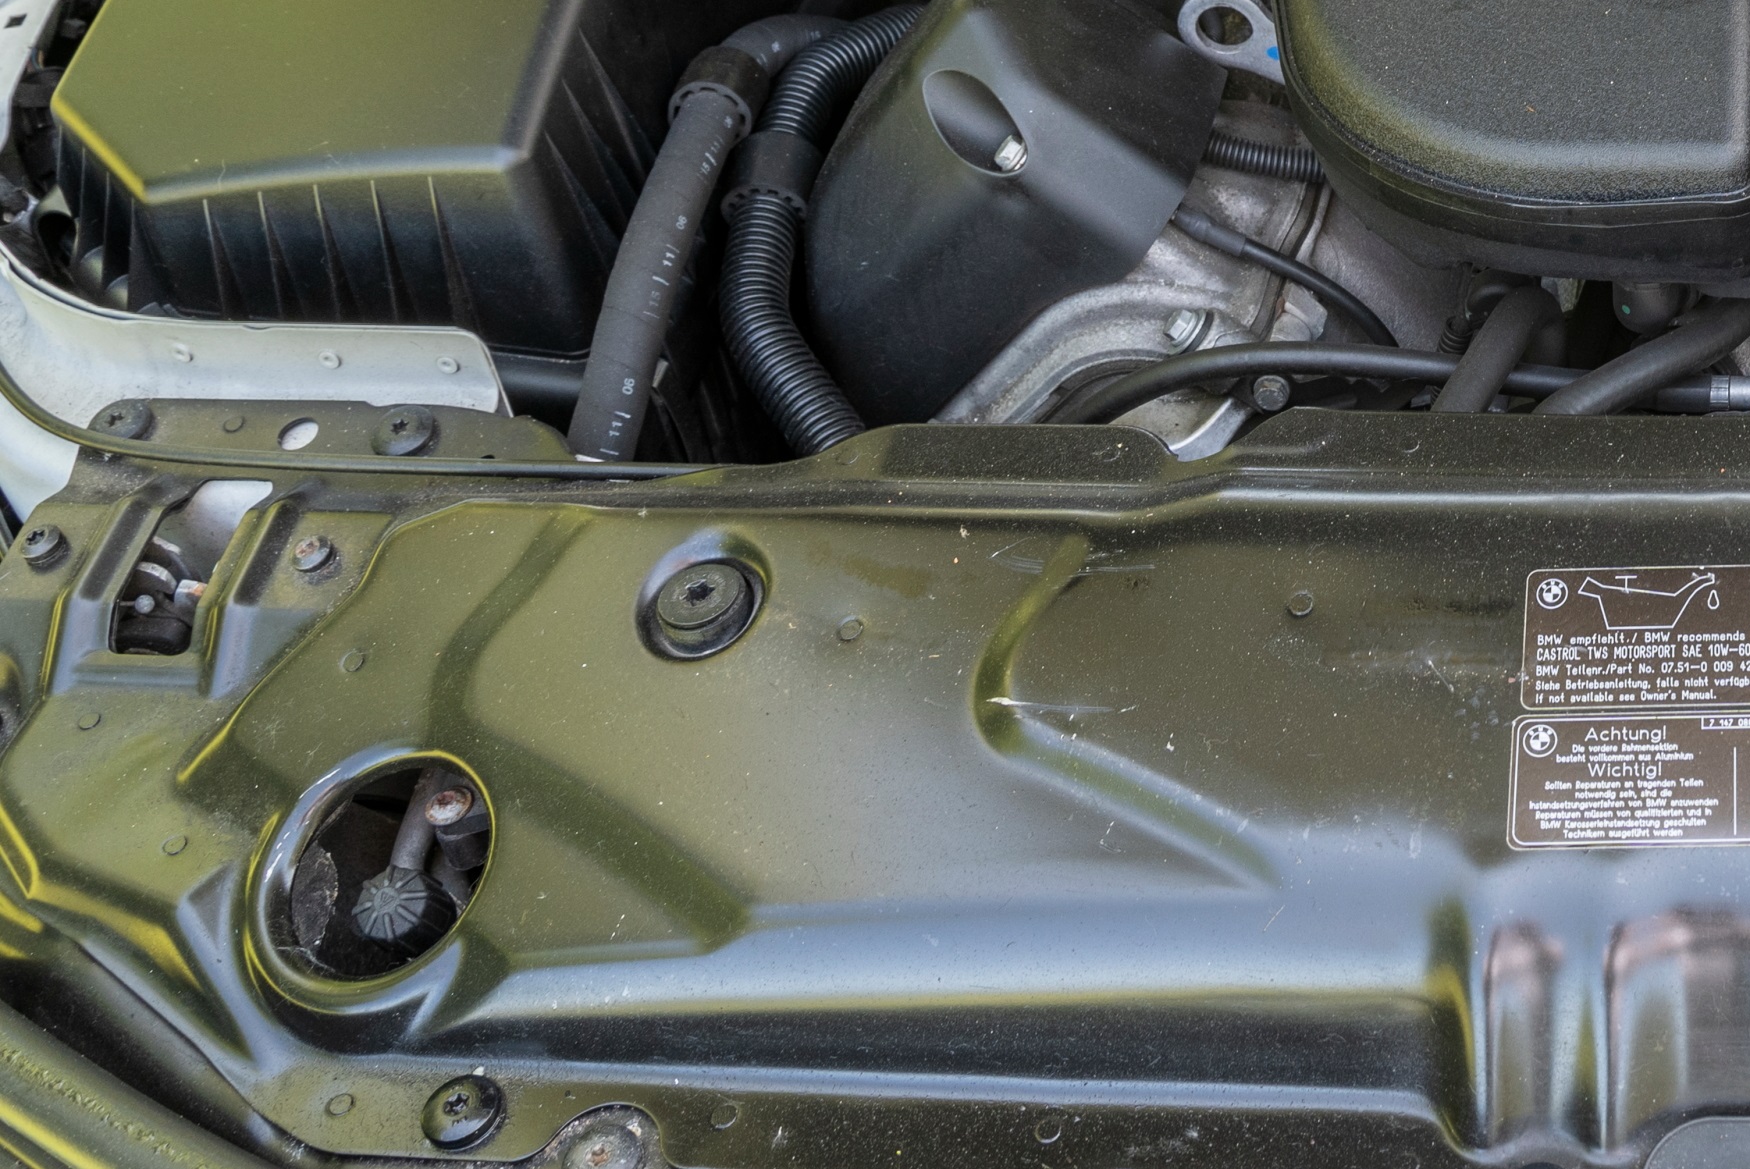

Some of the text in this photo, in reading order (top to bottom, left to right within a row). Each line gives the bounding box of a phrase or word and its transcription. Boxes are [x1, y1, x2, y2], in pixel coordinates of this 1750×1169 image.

[1537, 635, 1563, 646] BMW
[1644, 632, 1670, 643] BMW
[1677, 631, 1745, 642] recommends
[1537, 643, 1750, 661] CASTROL TWS MOTORSPORT SAE 10W-60
[1536, 665, 1559, 676] BMW
[1639, 663, 1654, 673] No.
[1661, 662, 1708, 673] 07.51-0
[1714, 661, 1734, 672] 009
[1535, 679, 1560, 691] Siehe
[1566, 678, 1650, 690] Betriebsanleitung,
[1657, 677, 1679, 688] falls
[1685, 676, 1708, 687] nicht
[1535, 689, 1717, 703] If not available see Owner's Manual.
[1585, 725, 1667, 742] Achtung!
[1572, 743, 1678, 753] Die vordere Rahmensektion
[1556, 754, 1586, 763] besteht
[1588, 762, 1662, 779] Wichtig!
[1545, 781, 1572, 790] Sollten
[1575, 780, 1620, 790] Reparaturen
[1575, 790, 1616, 800] notwendig
[1646, 799, 1666, 808] BMW
[1535, 810, 1581, 820] Reparaturen
[1617, 809, 1630, 817] von
[1687, 807, 1702, 816] und
[1540, 821, 1561, 829] BMW
[1664, 818, 1706, 827] geschulten
[1653, 828, 1683, 836] werden
